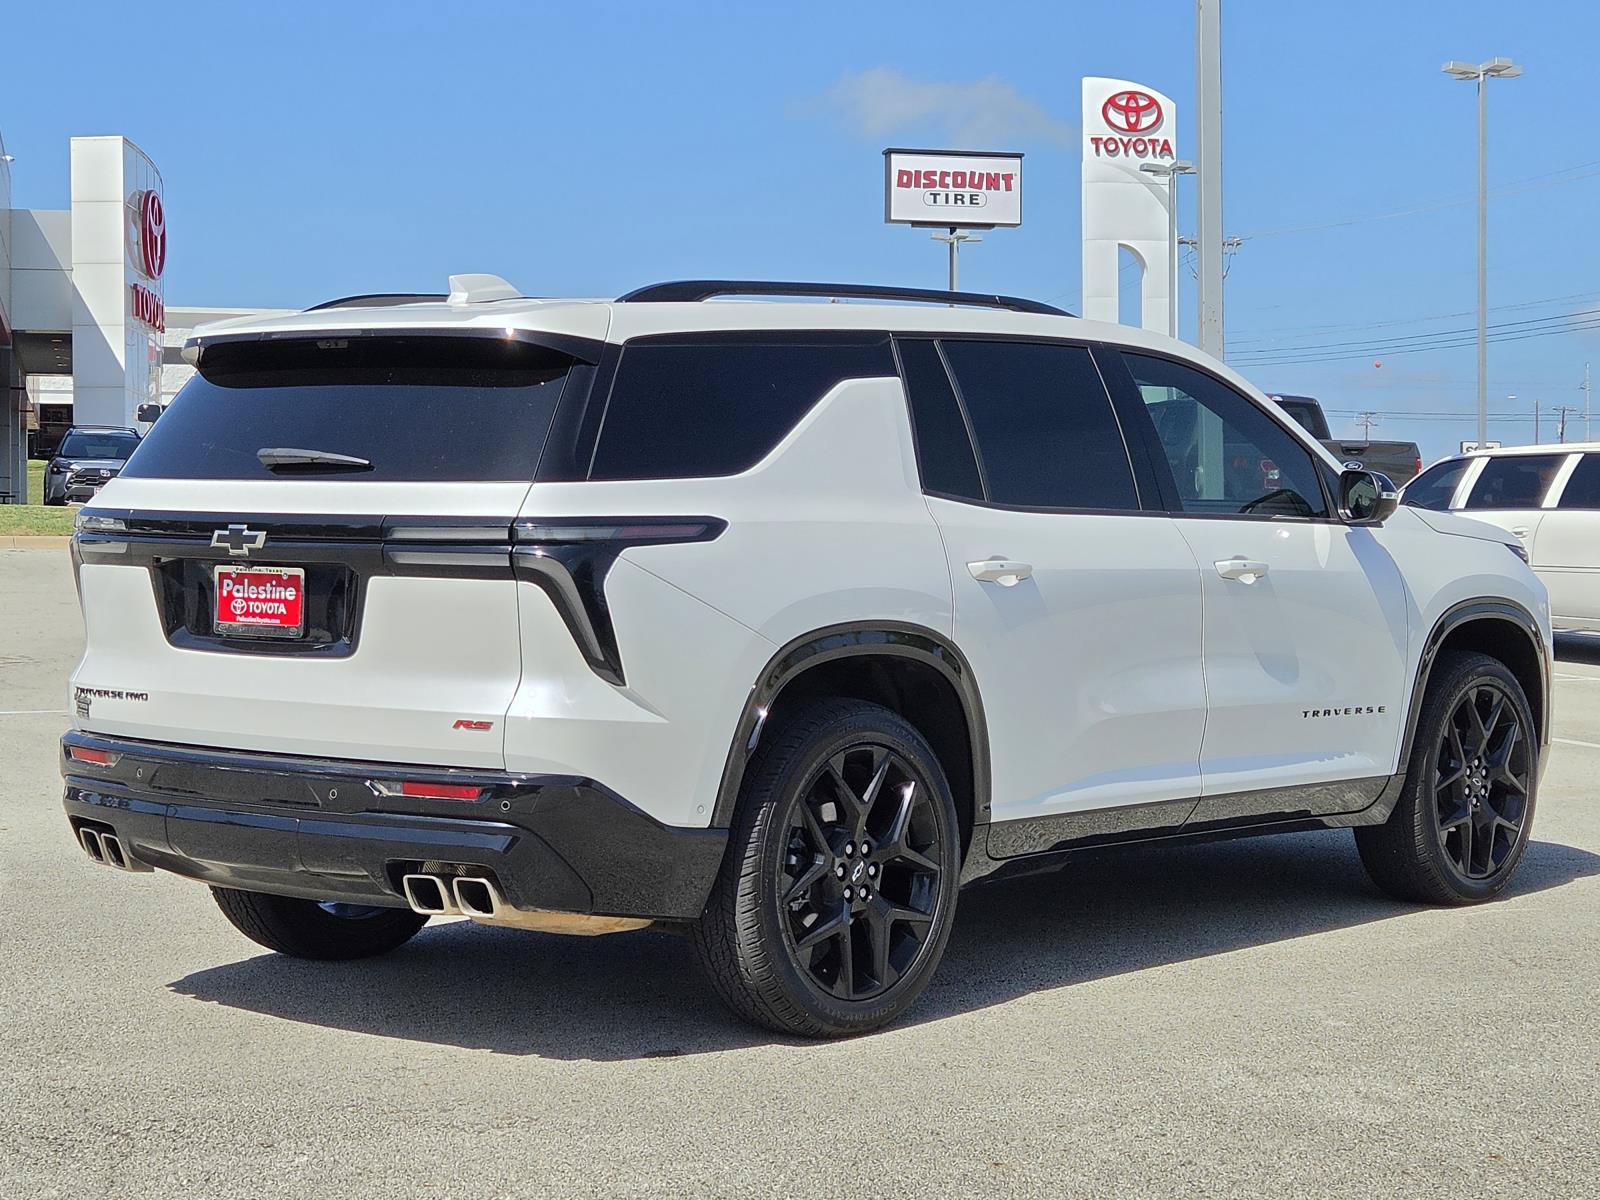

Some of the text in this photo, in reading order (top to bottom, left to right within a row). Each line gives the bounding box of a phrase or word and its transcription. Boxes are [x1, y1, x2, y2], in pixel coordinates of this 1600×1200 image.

[1091, 137, 1174, 159] TOYOTA
[897, 169, 1014, 191] DISCOUNT
[929, 193, 980, 205] TIRE
[222, 578, 297, 600] Palestine
[248, 601, 287, 614] TOYOTA
[76, 686, 149, 701] TRAVERSE AWD
[1302, 706, 1386, 719] TRAVERSE
[452, 719, 494, 731] RS
